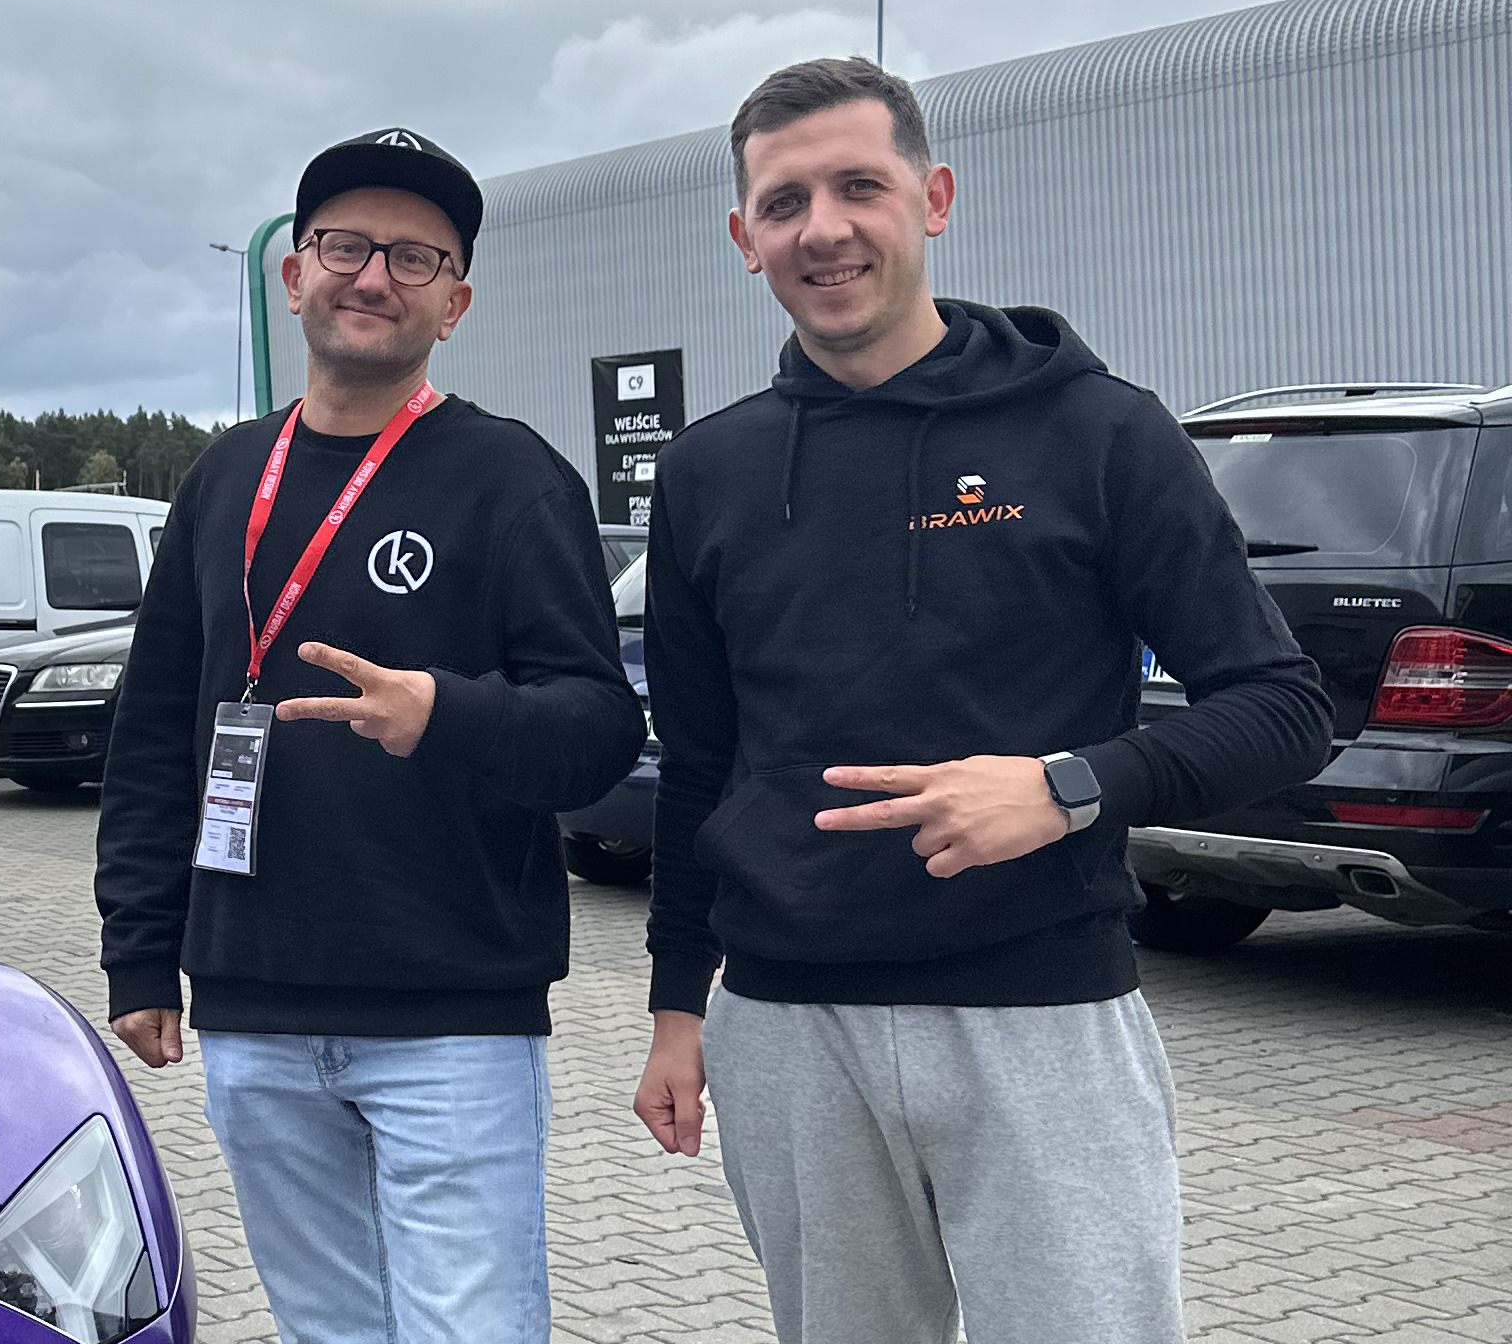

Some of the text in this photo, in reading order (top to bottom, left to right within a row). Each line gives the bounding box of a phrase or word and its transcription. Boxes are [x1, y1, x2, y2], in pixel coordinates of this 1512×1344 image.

[628, 375, 643, 390] C9
[614, 412, 660, 431] WEJŚCIE
[1333, 597, 1402, 608] BLUETEC
